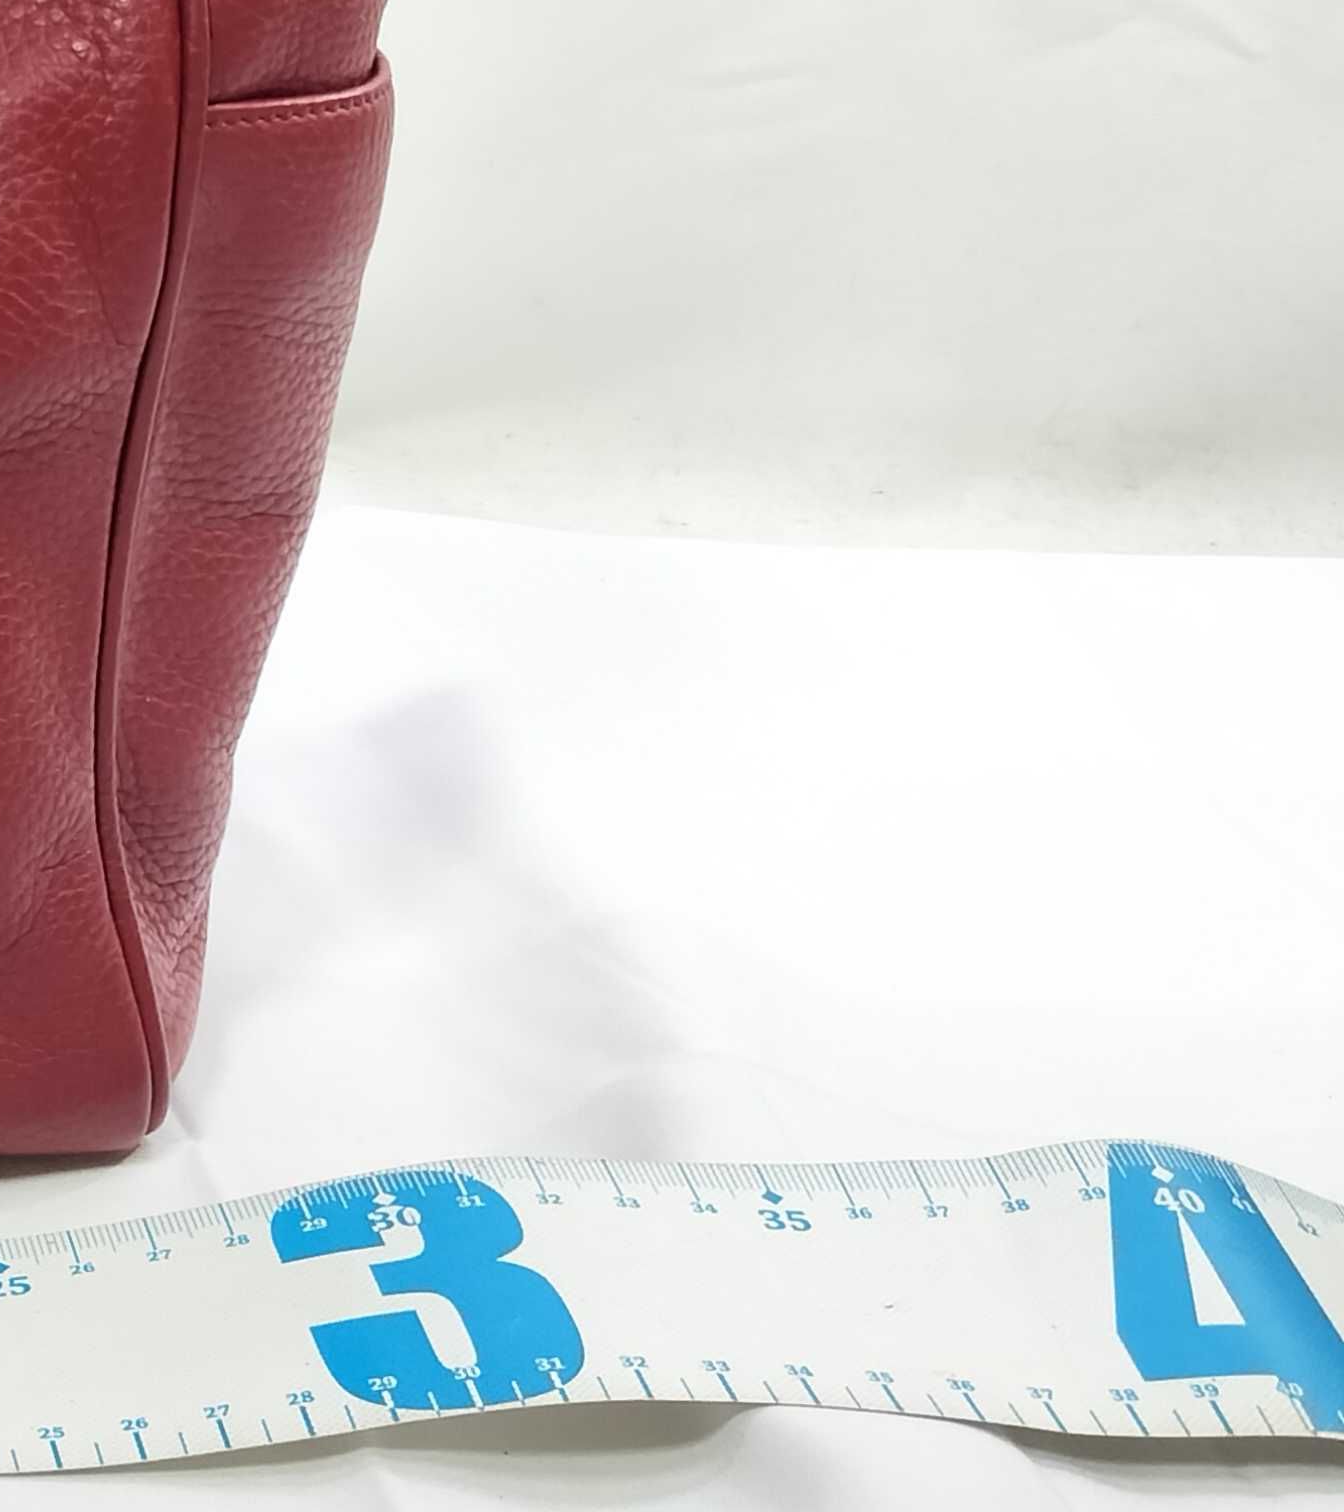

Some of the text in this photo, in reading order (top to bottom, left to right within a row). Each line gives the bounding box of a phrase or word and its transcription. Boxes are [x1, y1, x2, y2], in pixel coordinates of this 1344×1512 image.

[69, 1262, 96, 1275] 26
[146, 1249, 172, 1261] 27
[224, 1234, 250, 1247] 28
[300, 1218, 327, 1232] 29
[367, 1207, 422, 1232] 30
[456, 1195, 486, 1208] 31
[536, 1194, 563, 1205] 32
[613, 1196, 640, 1209] 33
[690, 1201, 718, 1214] 34
[758, 1210, 812, 1232] 35
[846, 1207, 872, 1220] 36
[923, 1206, 949, 1219] 37
[1001, 1199, 1030, 1214] 38
[1078, 1187, 1106, 1202] 39
[1153, 1188, 1206, 1215] 40
[270, 1169, 584, 1410] 3
[1107, 1142, 1344, 1432] 4
[38, 1427, 65, 1439] 25
[121, 1417, 149, 1431] 26
[203, 1404, 230, 1419] 27
[286, 1390, 315, 1407] 28
[368, 1375, 398, 1391] 29
[452, 1365, 481, 1381] 30
[534, 1357, 565, 1373] 31
[619, 1356, 648, 1369] 32
[702, 1360, 730, 1373] 33
[784, 1363, 813, 1378] 34
[865, 1370, 894, 1385] 35
[946, 1377, 976, 1393] 36
[1027, 1386, 1054, 1401] 37
[1108, 1388, 1139, 1402] 38
[1189, 1382, 1220, 1398] 39
